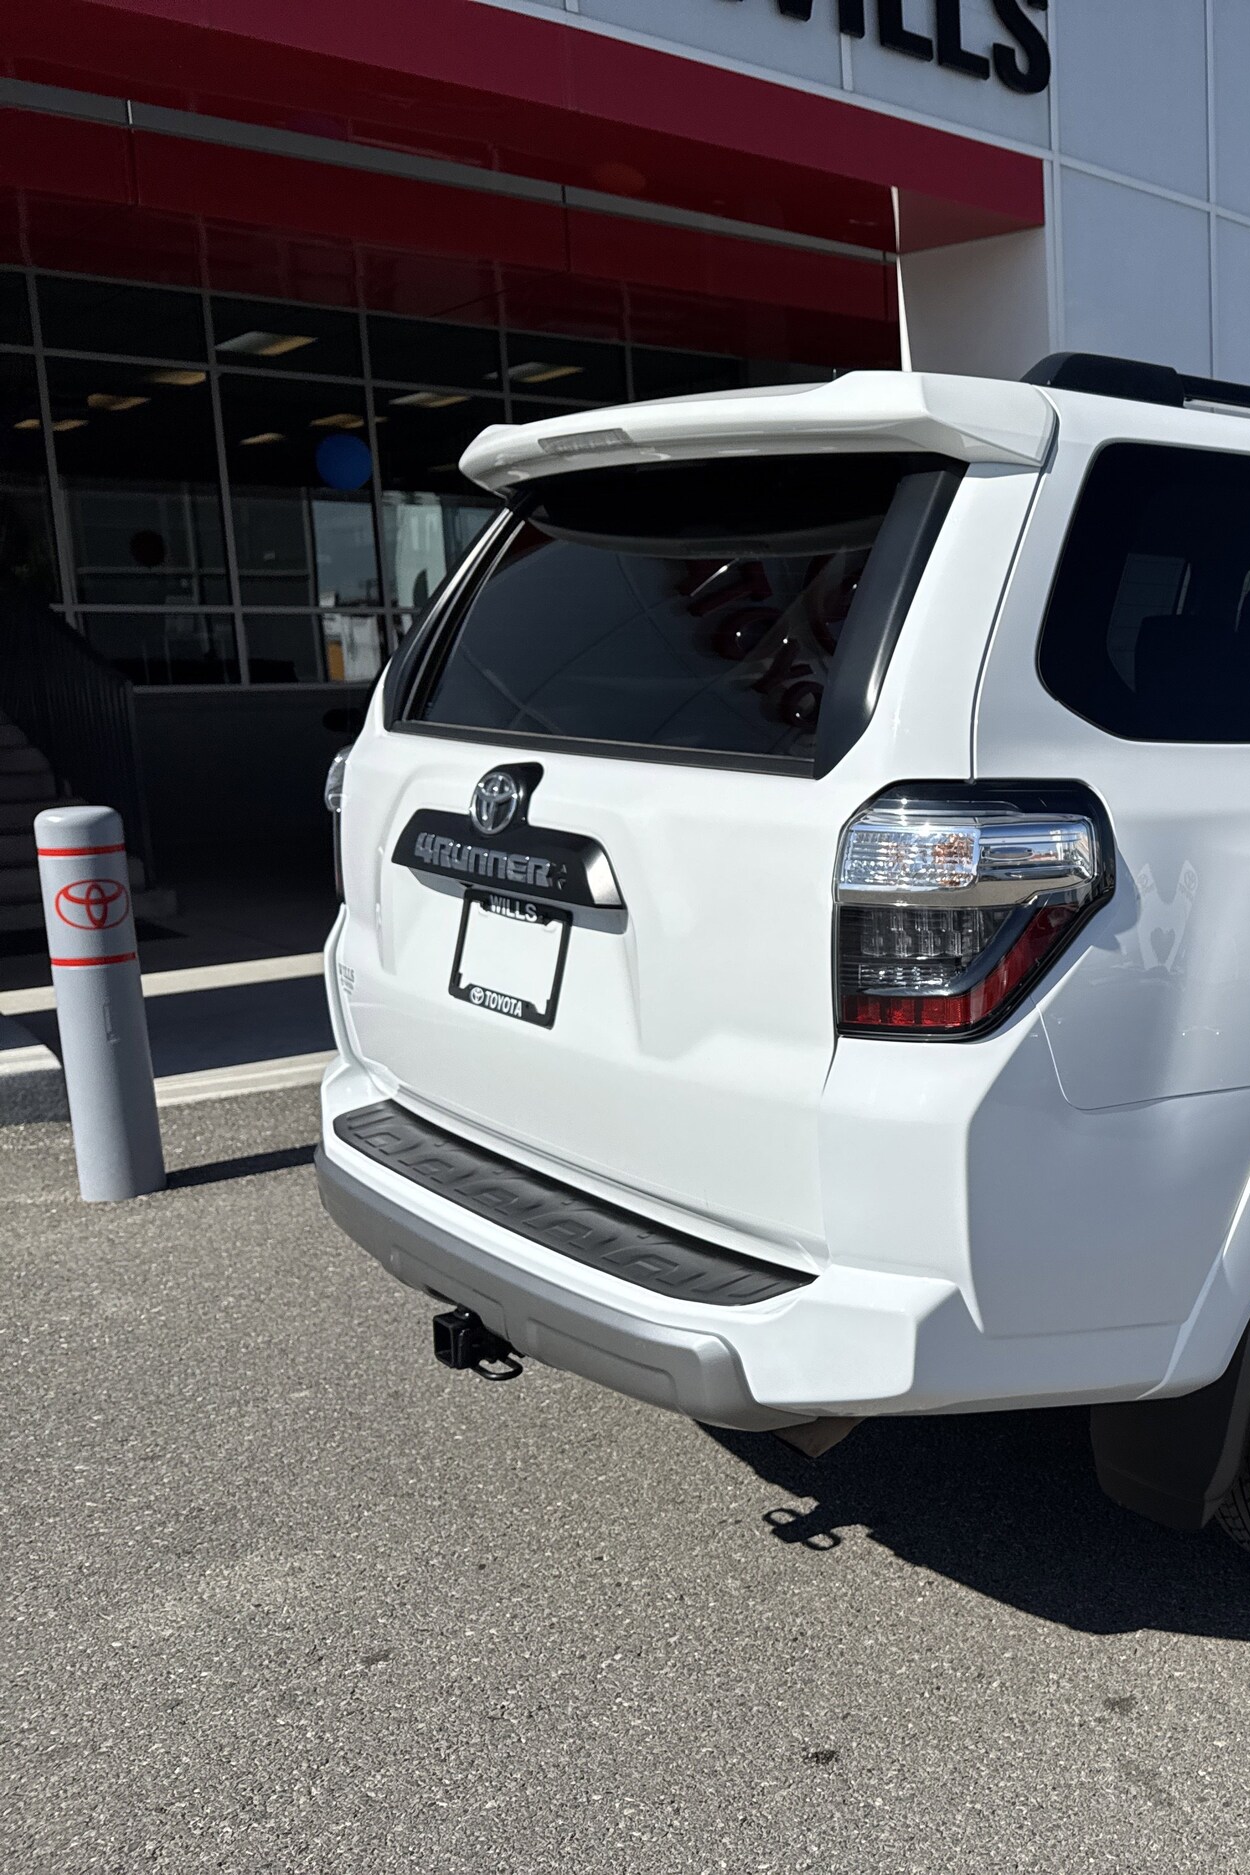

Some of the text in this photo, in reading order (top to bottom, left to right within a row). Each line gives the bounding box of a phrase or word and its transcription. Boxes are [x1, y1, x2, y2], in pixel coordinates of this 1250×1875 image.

[414, 832, 552, 887] 4RUNNER
[489, 894, 538, 922] WILLS
[484, 991, 522, 1017] TOYOTA
